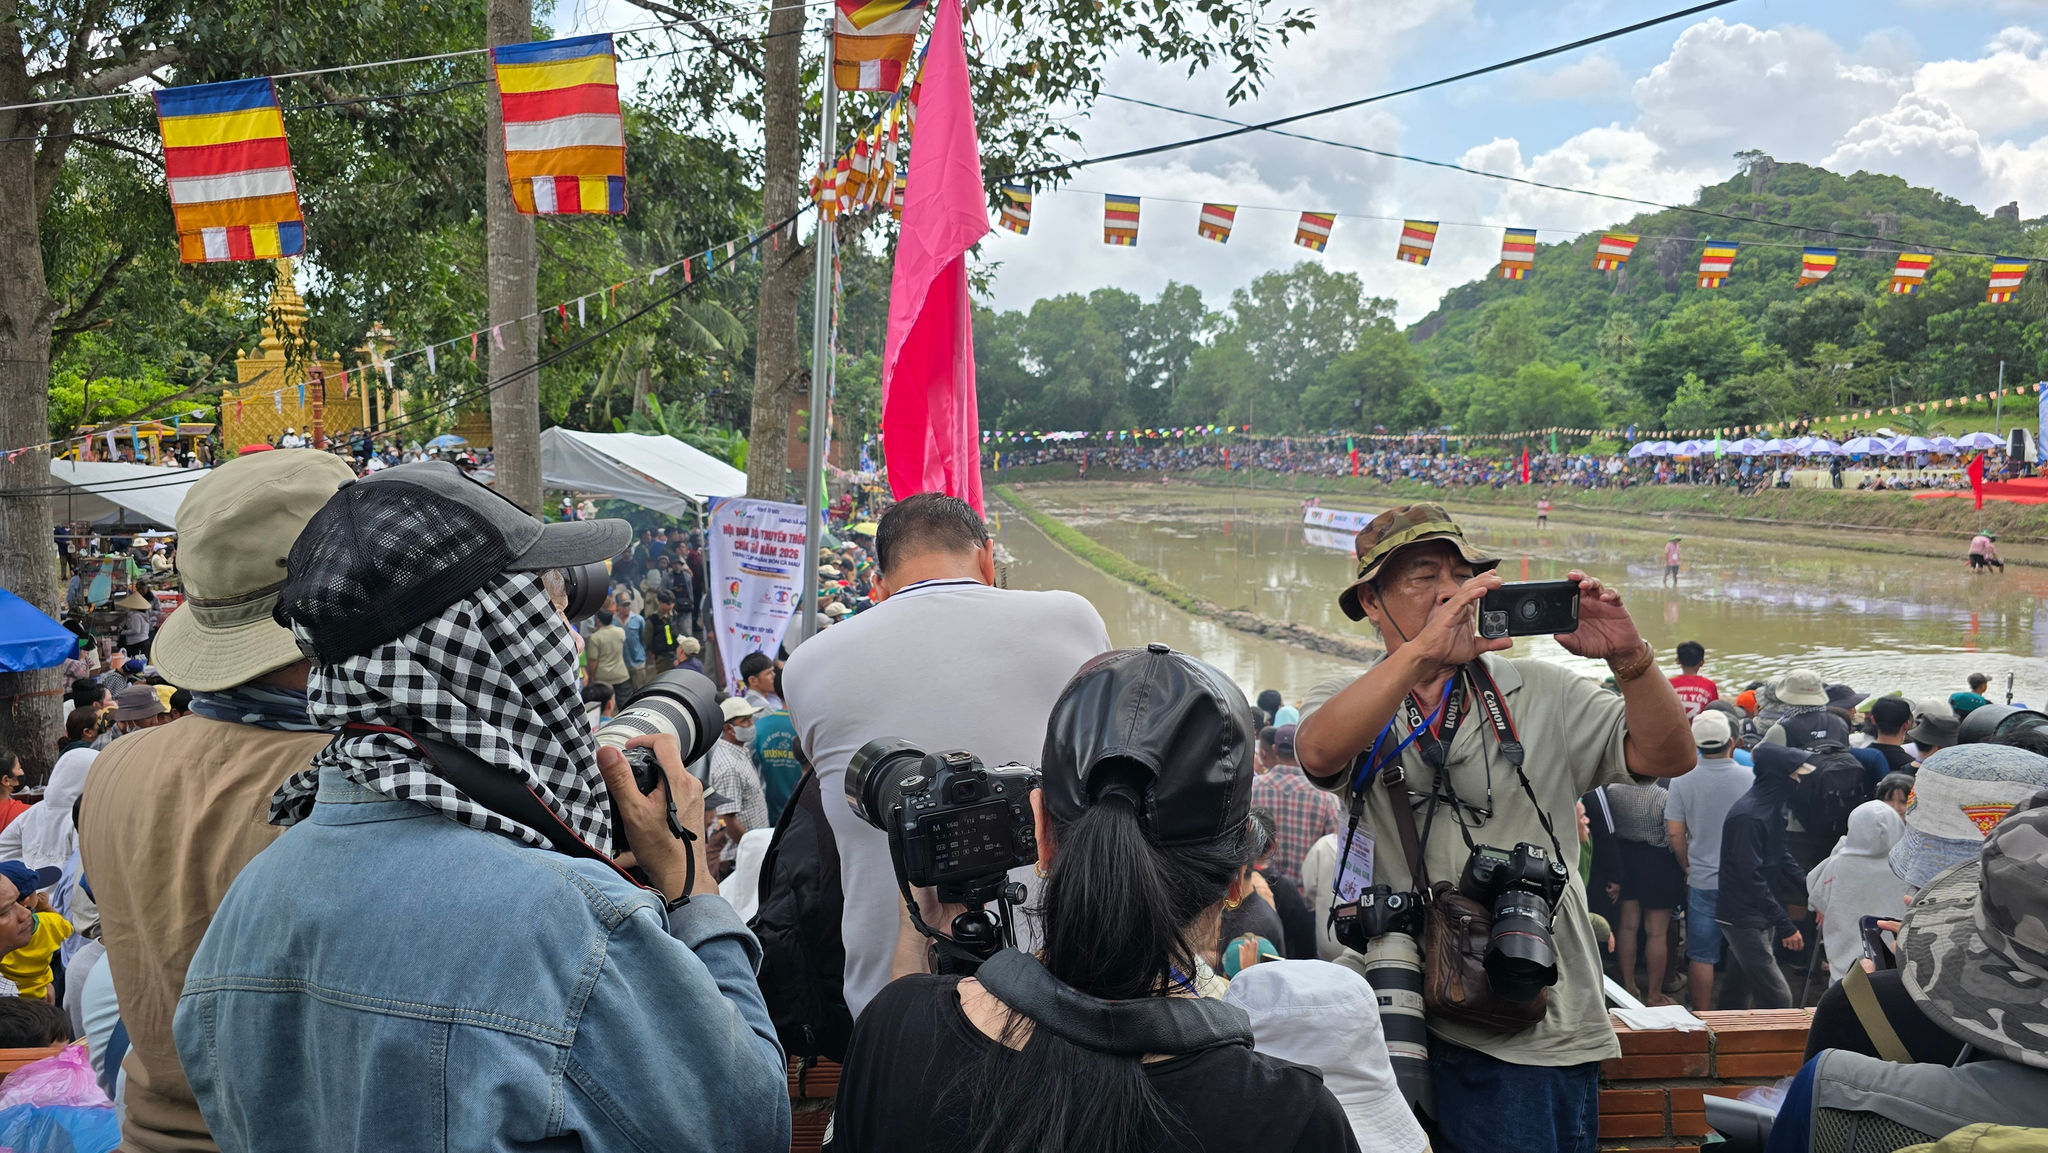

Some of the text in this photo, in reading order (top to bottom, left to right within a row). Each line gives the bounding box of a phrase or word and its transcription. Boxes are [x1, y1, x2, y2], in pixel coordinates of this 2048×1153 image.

[760, 529, 787, 543] TRUYỀN
[788, 532, 806, 546] THỐN
[760, 543, 777, 557] NĂM
[778, 547, 799, 560] 2026
[741, 632, 761, 643] VTV10
[1444, 688, 1461, 729] Canon
[1483, 690, 1506, 731] Canon
